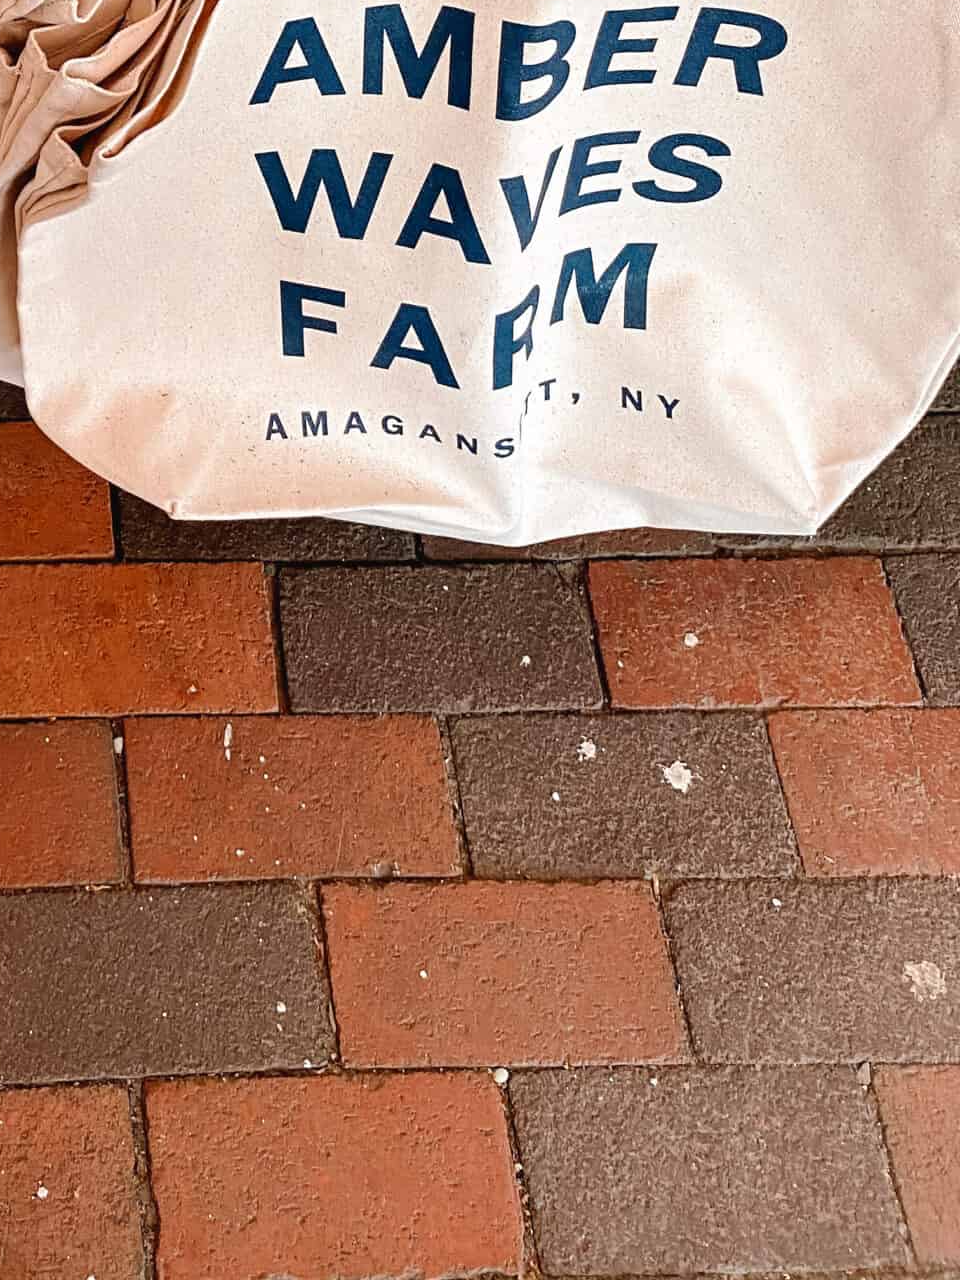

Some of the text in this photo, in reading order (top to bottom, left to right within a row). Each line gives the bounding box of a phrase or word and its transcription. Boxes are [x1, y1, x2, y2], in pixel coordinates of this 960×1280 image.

[249, 3, 788, 122] AMBER
[254, 130, 732, 265] WAVES
[279, 242, 658, 391] FARM
[265, 378, 680, 458] AMAGANST, NY
